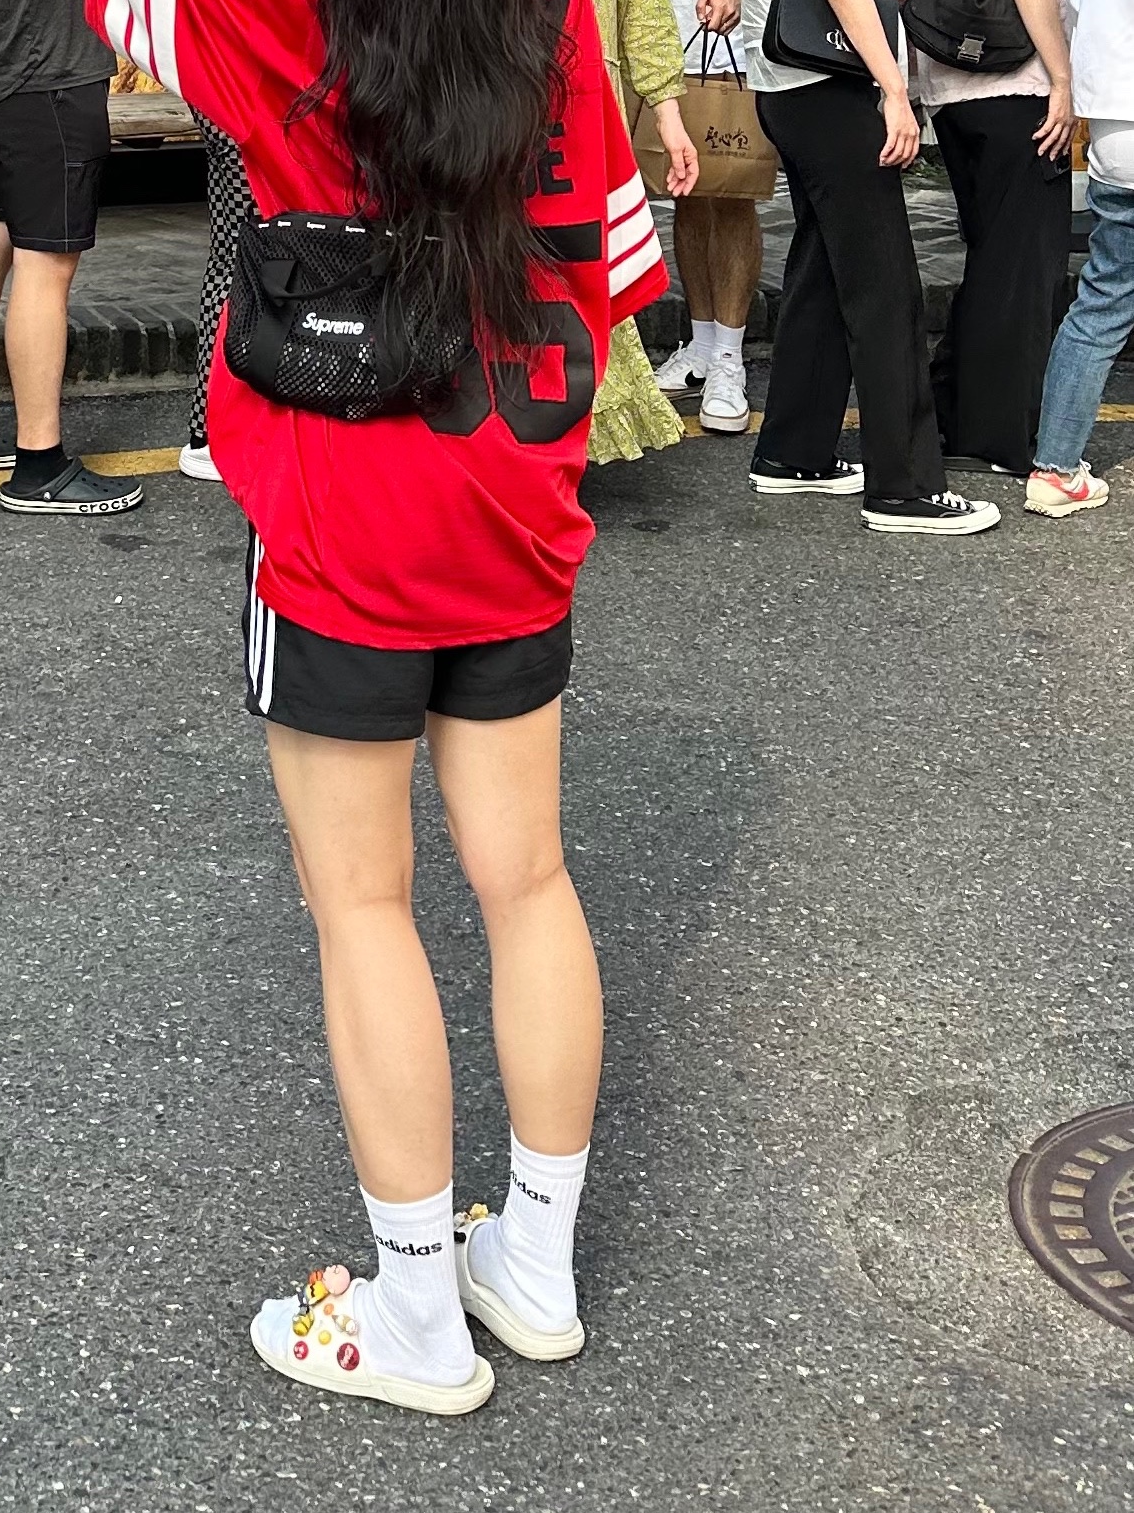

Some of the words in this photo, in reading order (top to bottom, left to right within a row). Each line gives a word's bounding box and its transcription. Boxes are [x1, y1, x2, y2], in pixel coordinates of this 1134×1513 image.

[302, 312, 365, 337] Supreme
[78, 497, 130, 514] crocs
[375, 1234, 443, 1257] adidas
